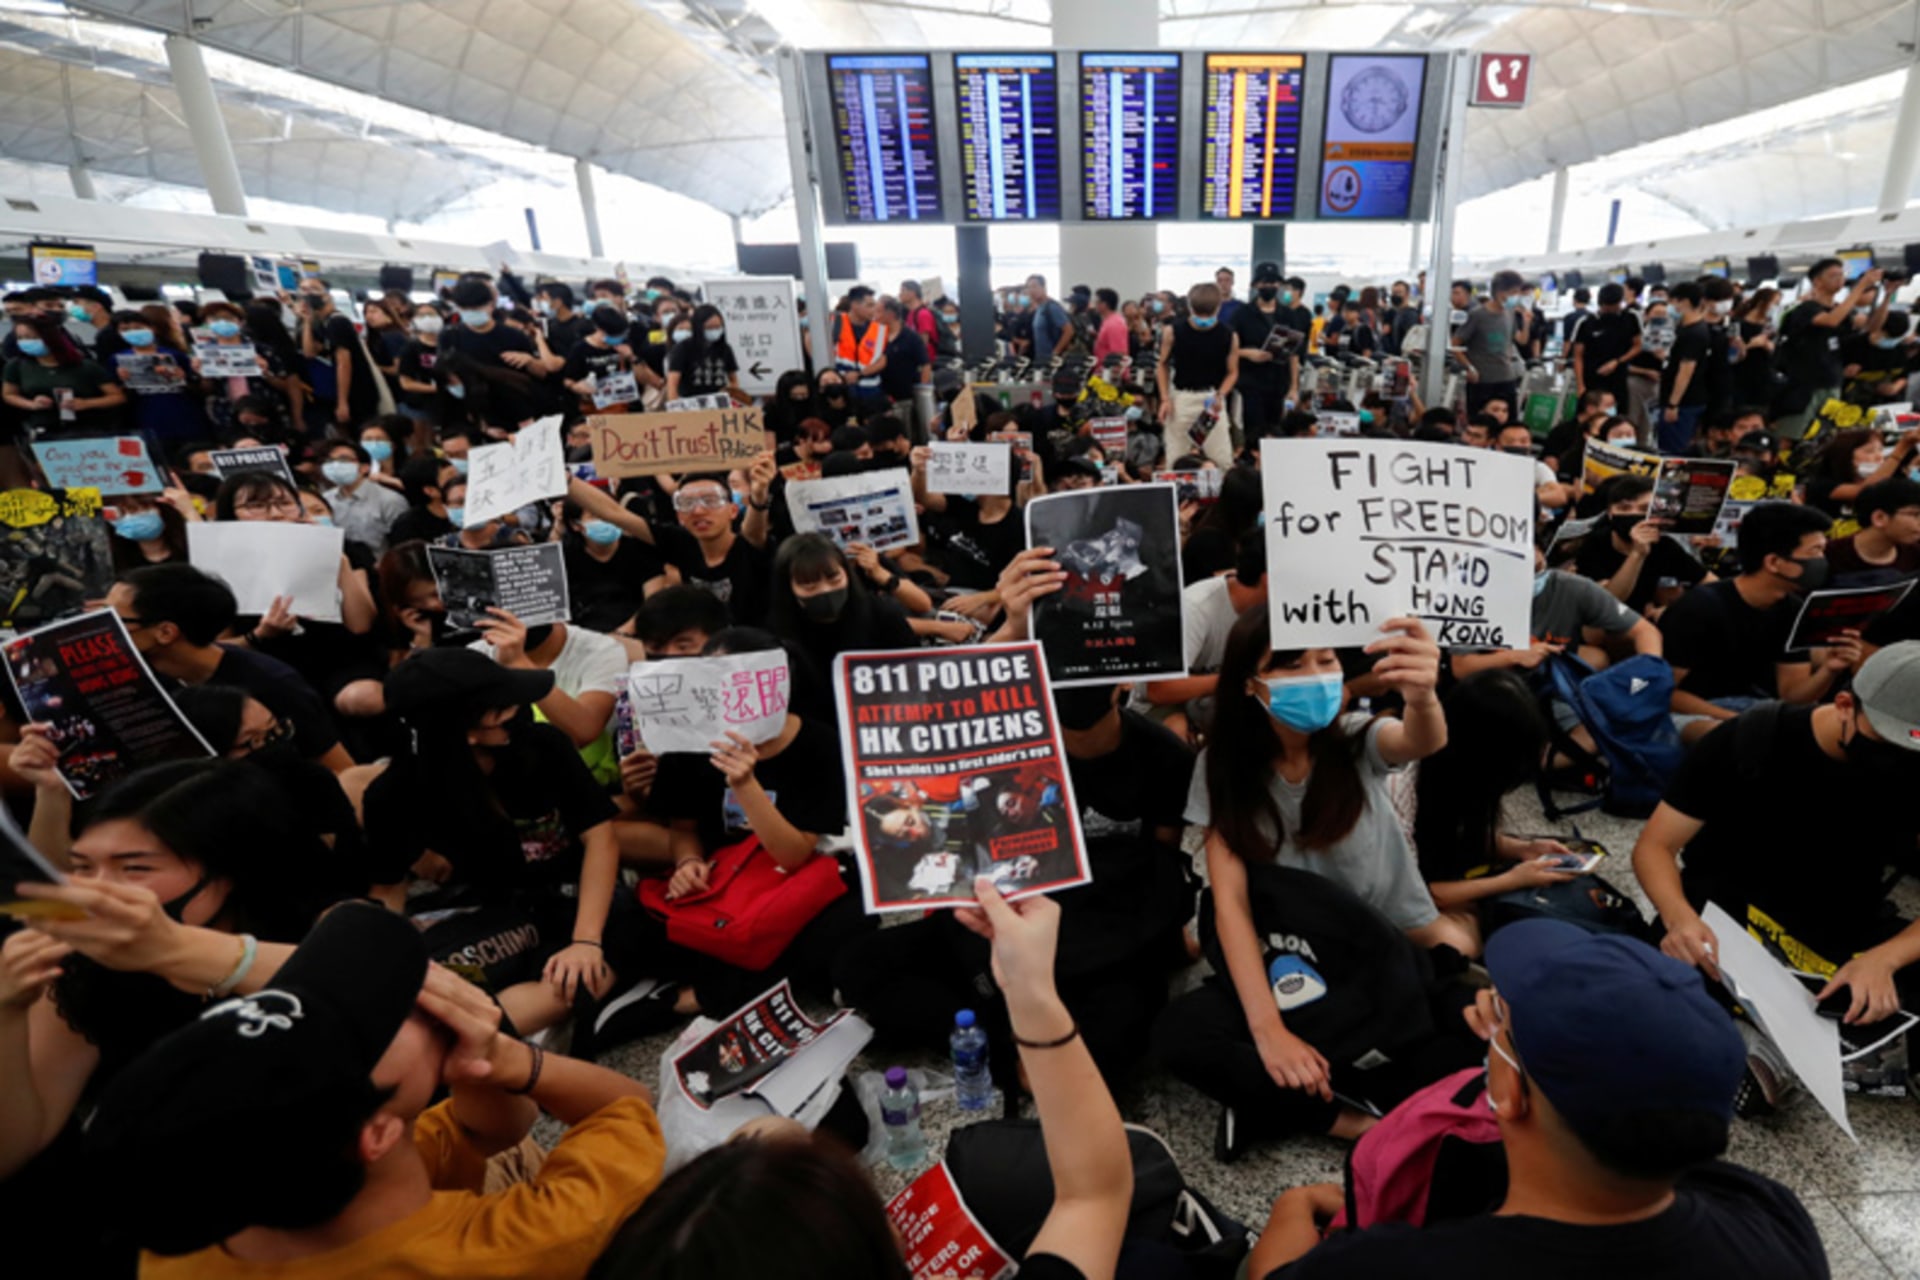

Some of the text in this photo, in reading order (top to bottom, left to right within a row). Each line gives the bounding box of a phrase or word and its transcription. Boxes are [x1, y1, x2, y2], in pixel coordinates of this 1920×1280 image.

[602, 422, 720, 461] Don't Trust
[1327, 451, 1477, 490] FIGHT
[1273, 496, 1529, 543] for FREEDOM
[1364, 542, 1490, 587] STAND
[1282, 586, 1485, 625] with HONG
[59, 632, 121, 667] PLEASE
[1438, 620, 1504, 645] KONG
[853, 655, 1031, 694] 811 POLICE
[857, 684, 1038, 723] ATTEMPT TO KILL
[859, 710, 1044, 754] HK CITIZENS
[865, 764, 895, 777] Shot
[896, 763, 932, 776] bullet
[933, 762, 946, 774] to
[958, 755, 985, 770] first
[744, 1009, 764, 1035] HK
[770, 991, 794, 1022] 811
